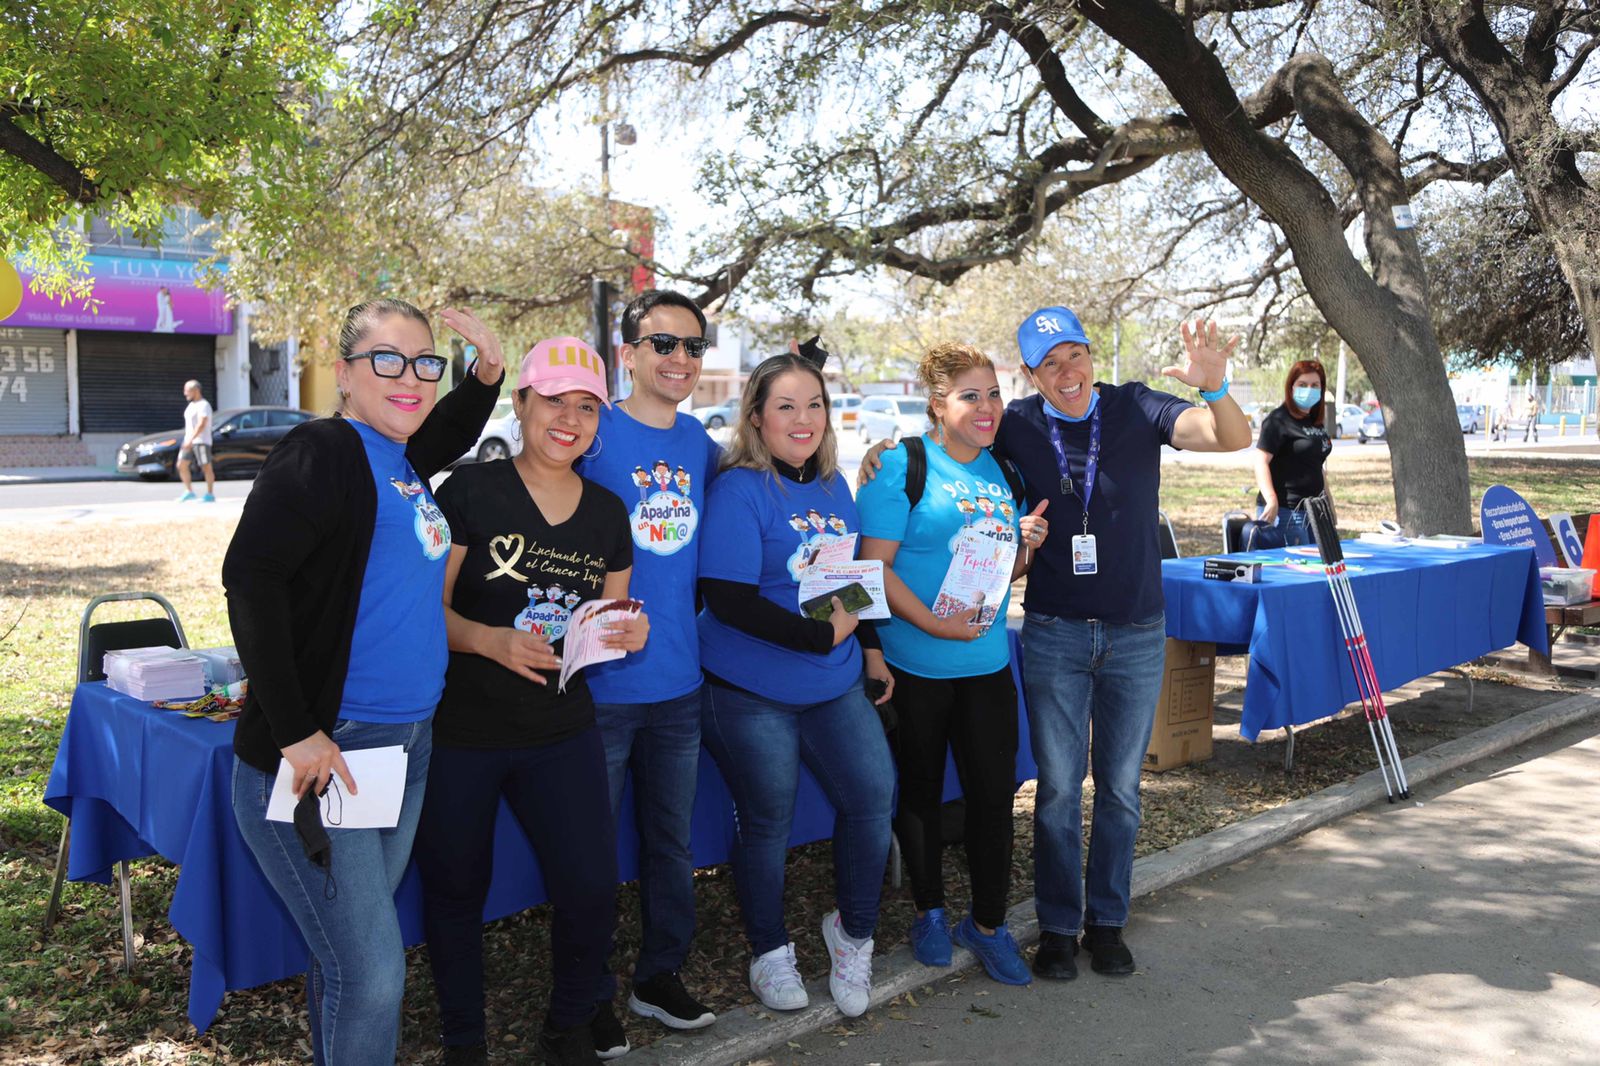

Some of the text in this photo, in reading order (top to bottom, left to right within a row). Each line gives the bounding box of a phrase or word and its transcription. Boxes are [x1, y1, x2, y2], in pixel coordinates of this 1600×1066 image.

[1036, 315, 1062, 335] SN
[548, 346, 600, 376] LILI
[640, 505, 691, 521] Apadrina
[638, 521, 649, 531] un
[527, 541, 582, 563] Luchando
[525, 558, 538, 569] el
[540, 560, 580, 577] Cáncer
[525, 610, 568, 622] Apadrina
